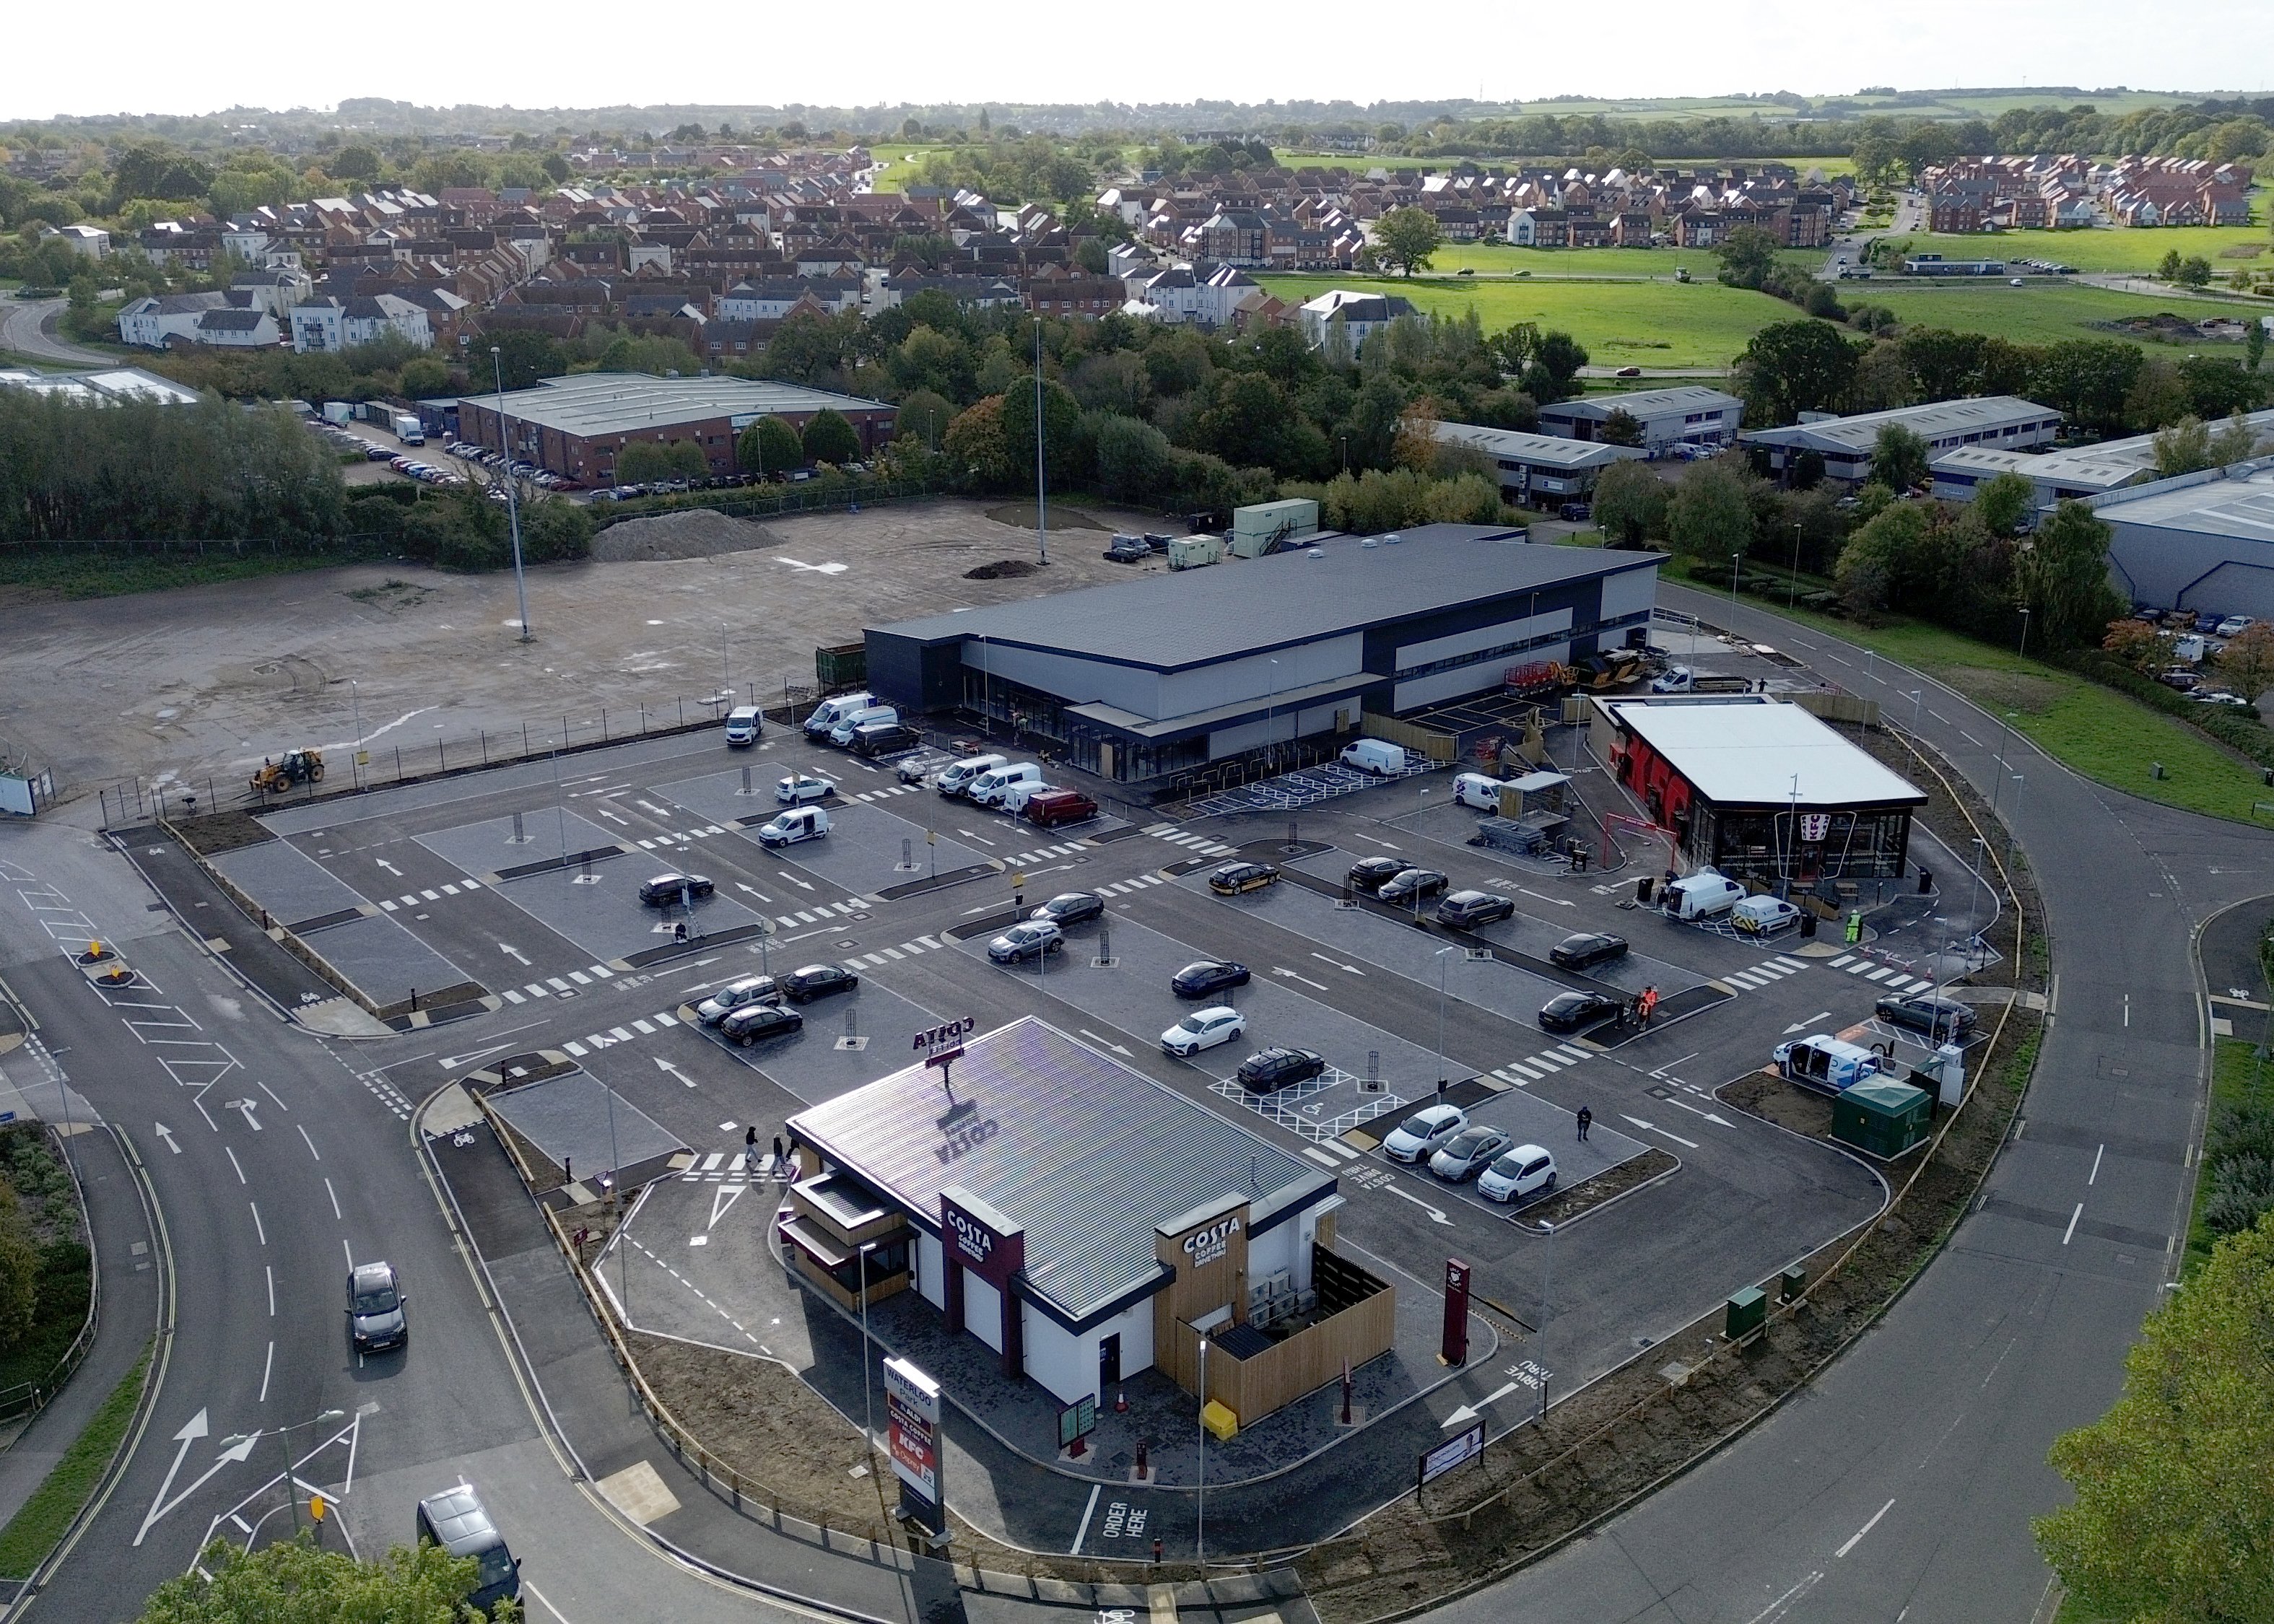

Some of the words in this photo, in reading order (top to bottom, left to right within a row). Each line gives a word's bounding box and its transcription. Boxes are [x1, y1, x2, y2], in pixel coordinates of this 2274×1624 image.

[1809, 816, 1821, 839] KFC
[1341, 1164, 1370, 1177] THRU
[1349, 1169, 1382, 1184] DRIVE
[1361, 1174, 1396, 1190] COSTA
[947, 1210, 992, 1252] COSTA
[1183, 1217, 1240, 1253] COSTA
[958, 1234, 984, 1256] COFFEE
[1195, 1240, 1226, 1260] COFFEE
[886, 1366, 931, 1407] WATERLOO
[1504, 1365, 1545, 1390] DRIVE
[899, 1388, 918, 1408] Park
[890, 1410, 909, 1428] COSTA
[909, 1424, 932, 1446] COFFEE
[906, 1408, 921, 1424] ALDI
[899, 1432, 924, 1460] KFC
[1102, 1502, 1128, 1538] ORDER
[1125, 1509, 1148, 1538] HERE
